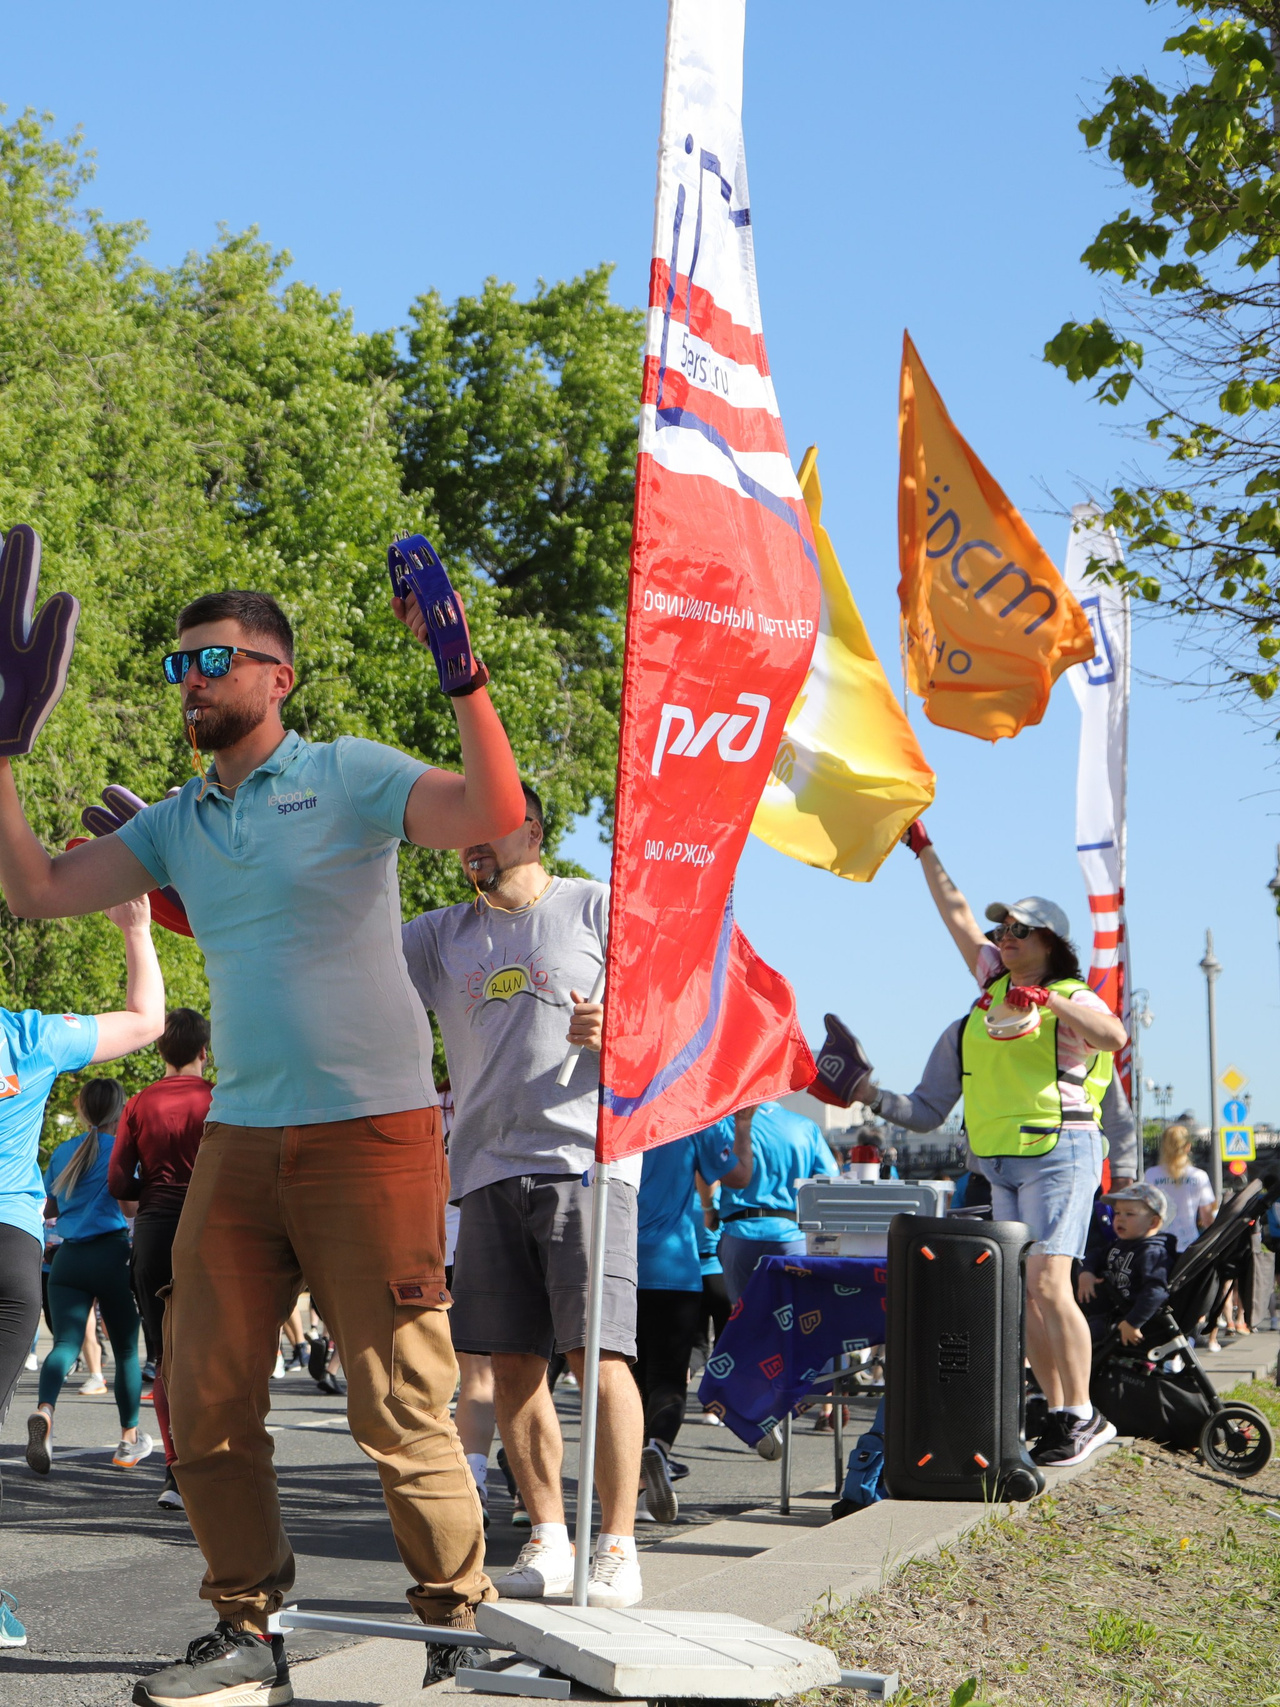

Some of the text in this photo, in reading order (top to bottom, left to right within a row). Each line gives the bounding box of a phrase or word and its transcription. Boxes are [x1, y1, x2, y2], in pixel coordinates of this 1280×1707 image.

[643, 589, 813, 640] ОФИЦИАЛЬНЫЙ ПАРТНЕР
[277, 795, 317, 815] sportif
[644, 839, 716, 867] ОАО «РЖД»
[491, 974, 523, 996] RUN
